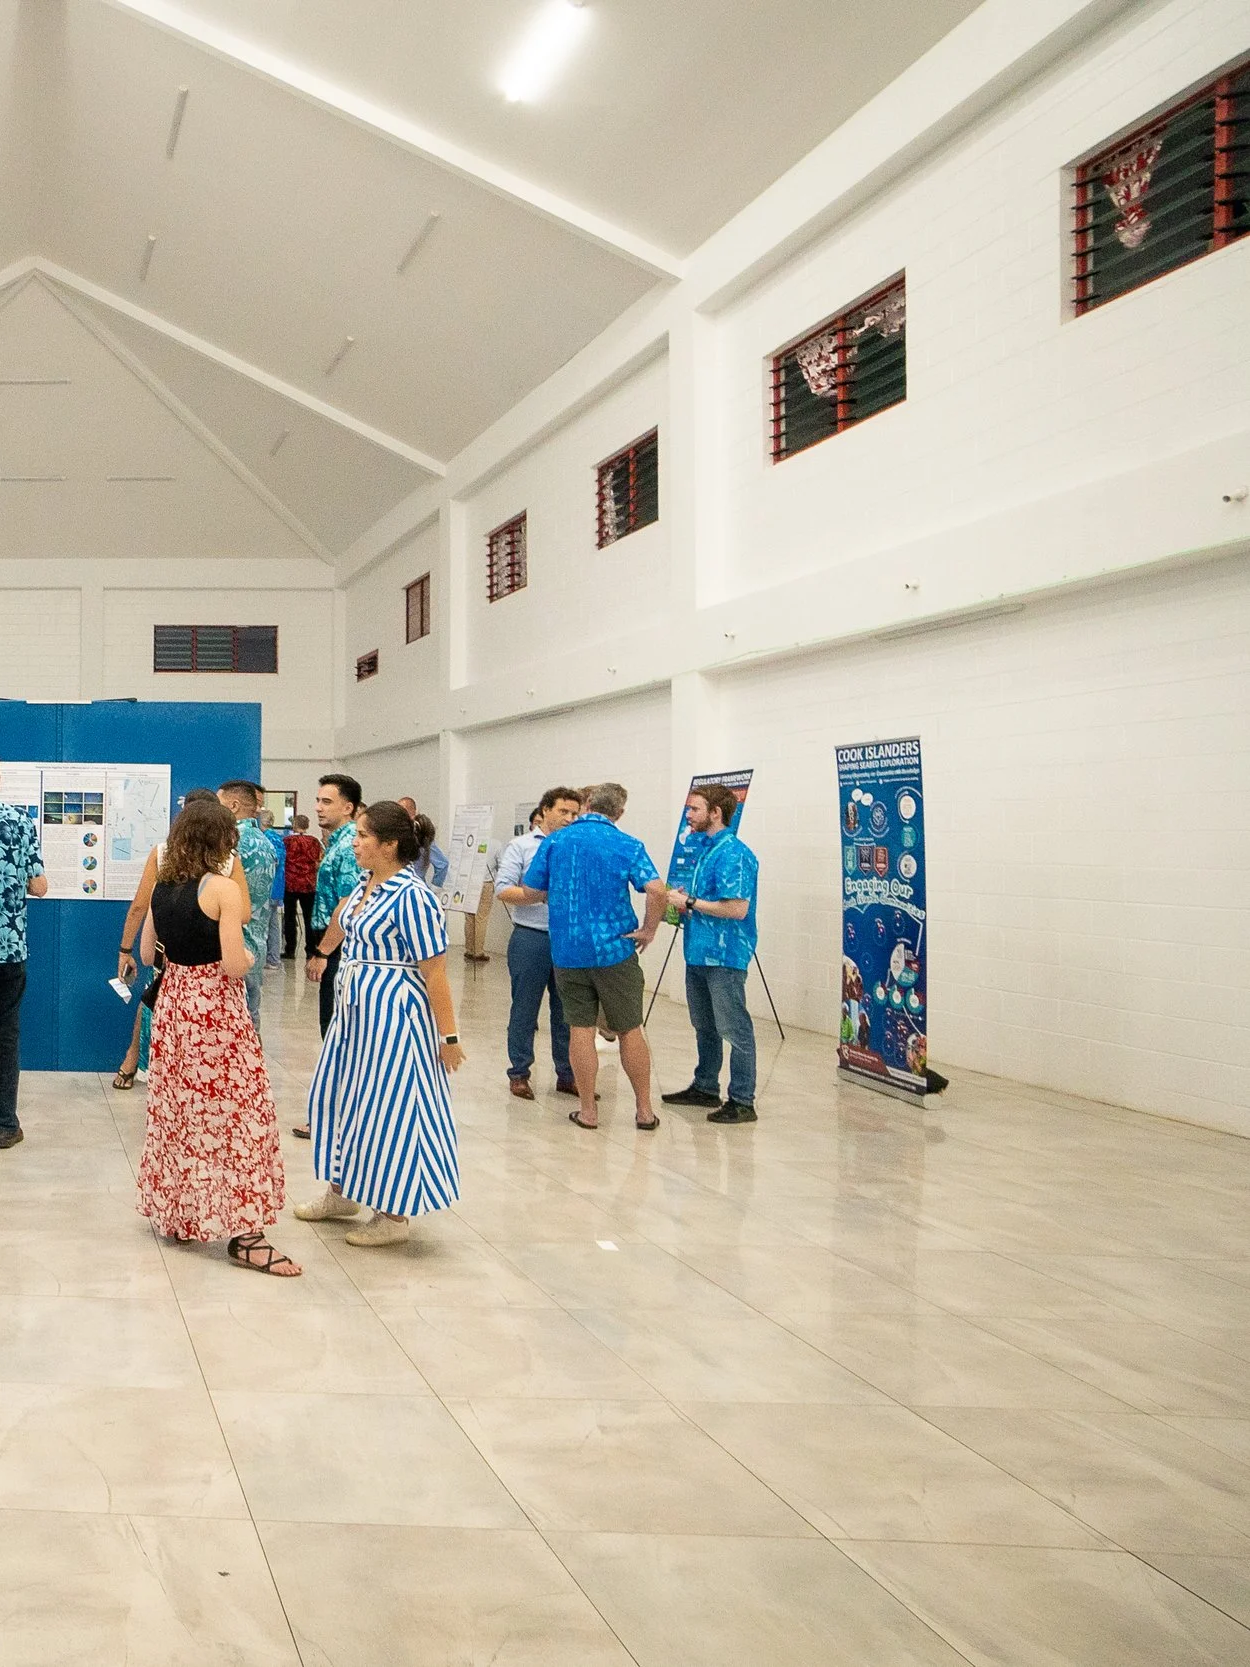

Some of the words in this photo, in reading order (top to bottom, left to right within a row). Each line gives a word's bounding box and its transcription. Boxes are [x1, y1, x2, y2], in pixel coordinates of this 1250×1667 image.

[838, 747, 863, 763] COOK
[865, 741, 920, 760] ISLANDERS
[859, 760, 880, 770] SEABED
[880, 756, 919, 768] EXPLORATION
[693, 777, 721, 786] REGULATORY
[722, 773, 751, 783] FRAMEWORK
[845, 877, 889, 896] Engaging
[890, 878, 913, 899] Our
